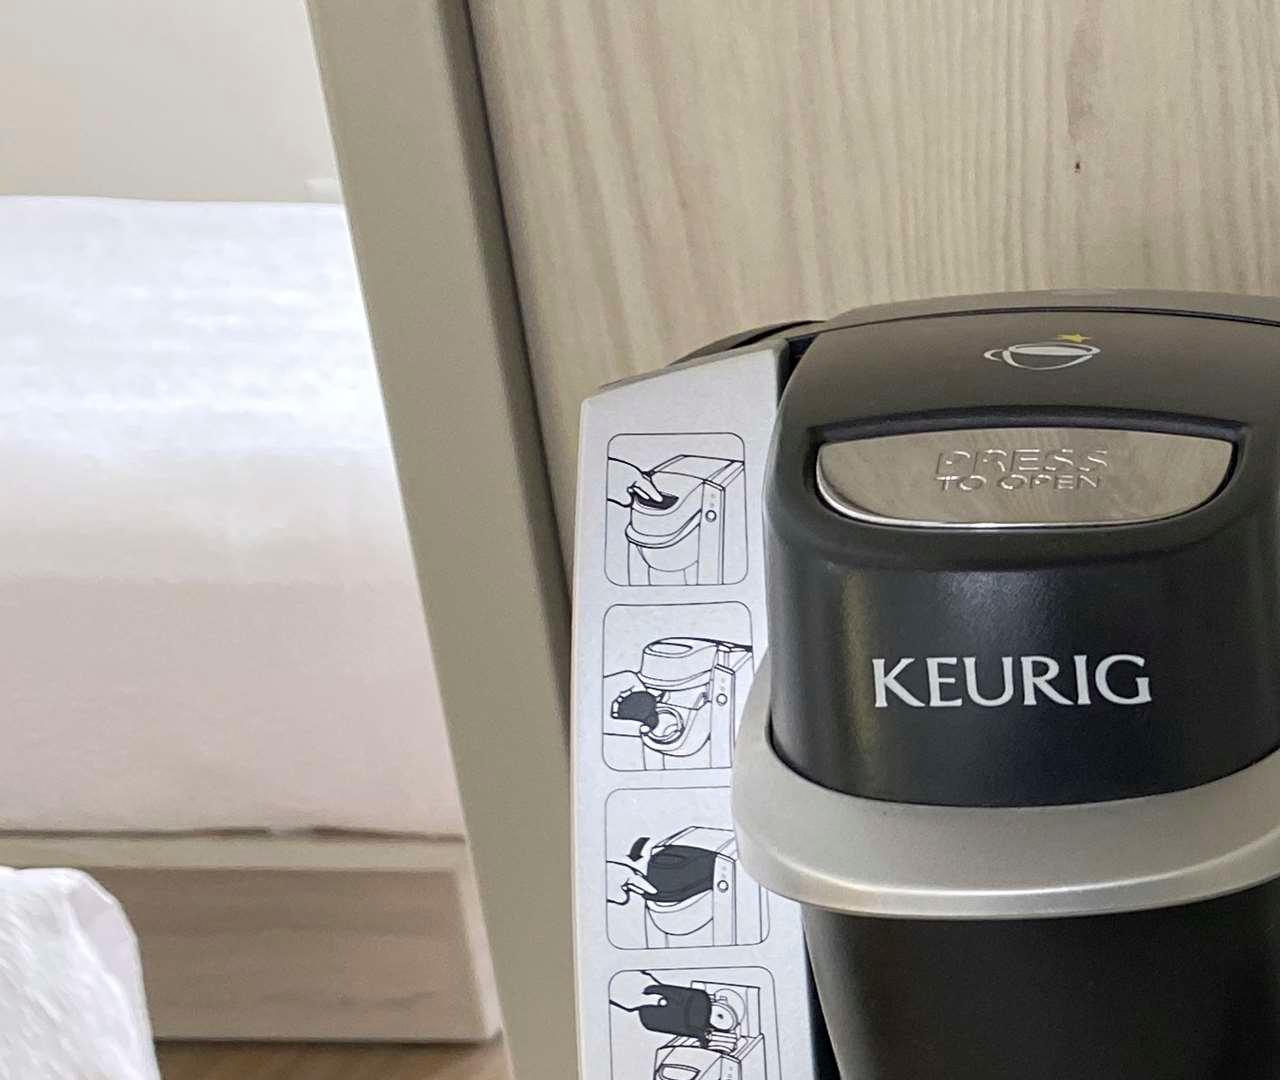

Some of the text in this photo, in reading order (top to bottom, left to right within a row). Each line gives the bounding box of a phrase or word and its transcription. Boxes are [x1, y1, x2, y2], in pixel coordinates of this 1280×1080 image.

[936, 449, 1107, 474] PRESS
[935, 474, 1100, 491] TO OPEN
[872, 654, 1151, 707] KEURIG
